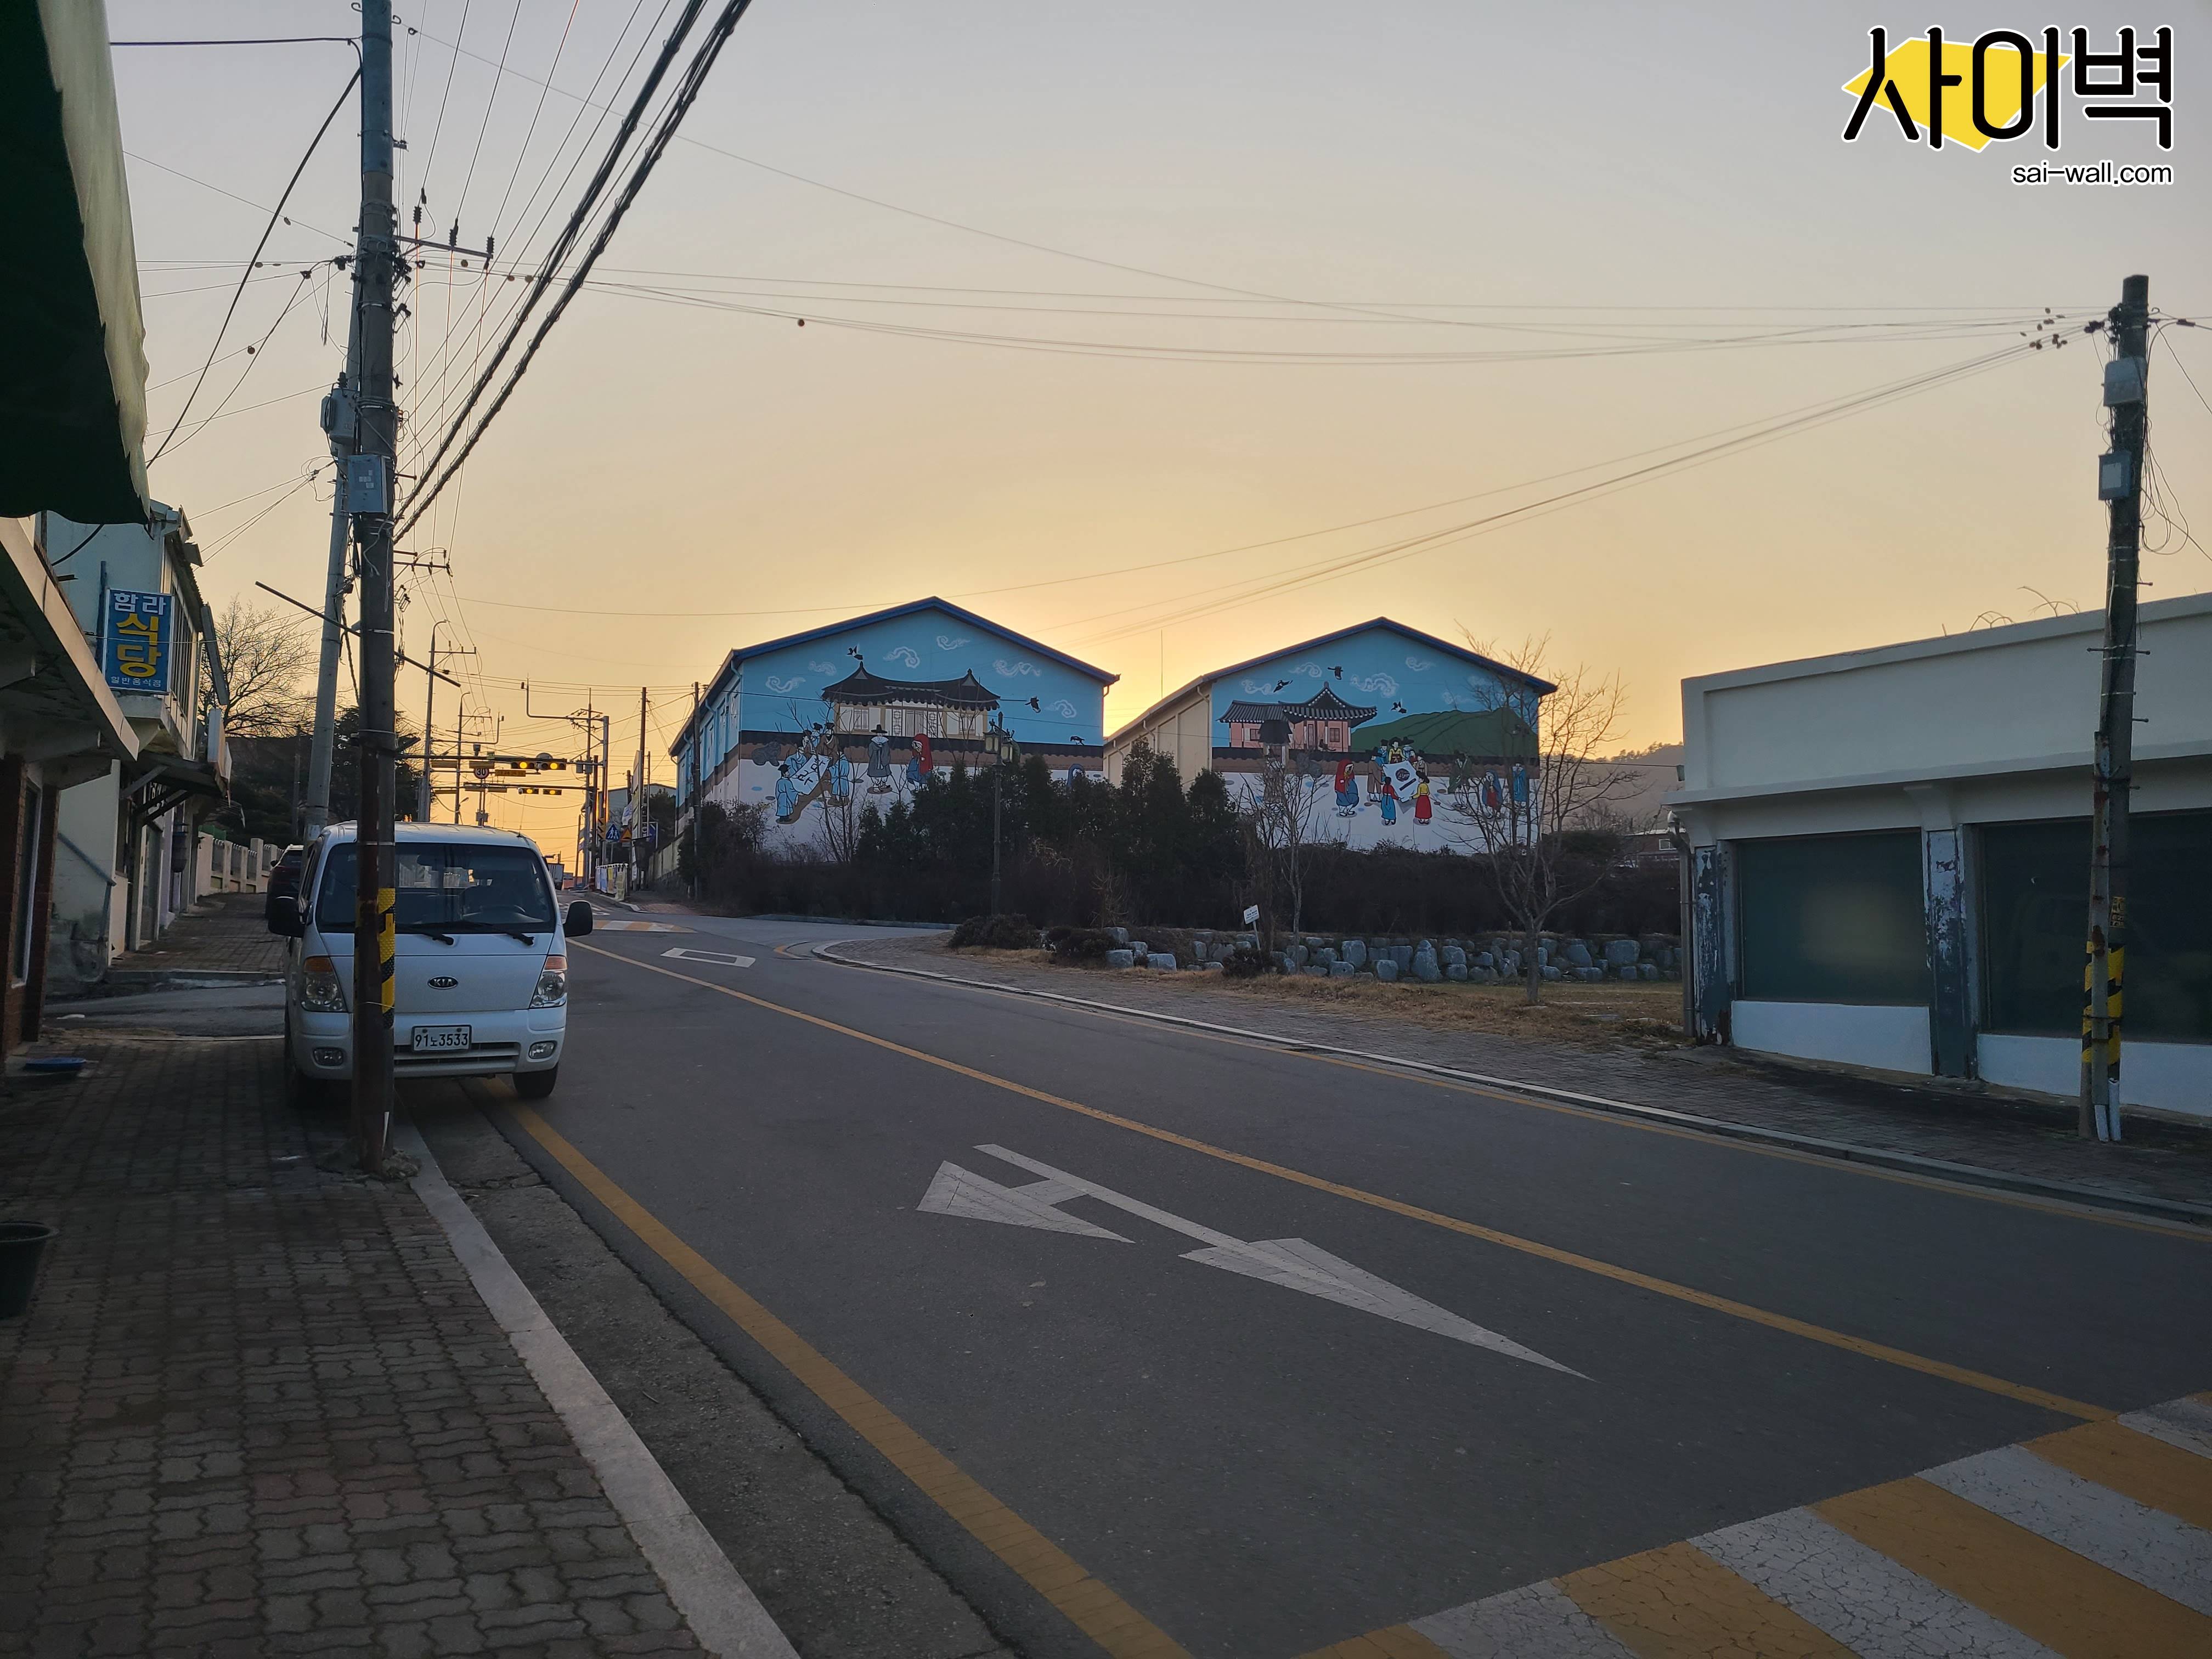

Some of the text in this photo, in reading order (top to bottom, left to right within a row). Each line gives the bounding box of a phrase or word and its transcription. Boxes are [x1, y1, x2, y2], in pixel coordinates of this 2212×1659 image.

[114, 592, 166, 615] 함라
[116, 613, 161, 677] 식당
[111, 676, 161, 687] 일반음식점
[477, 768, 486, 776] 30
[415, 1033, 468, 1047] 91노3533
